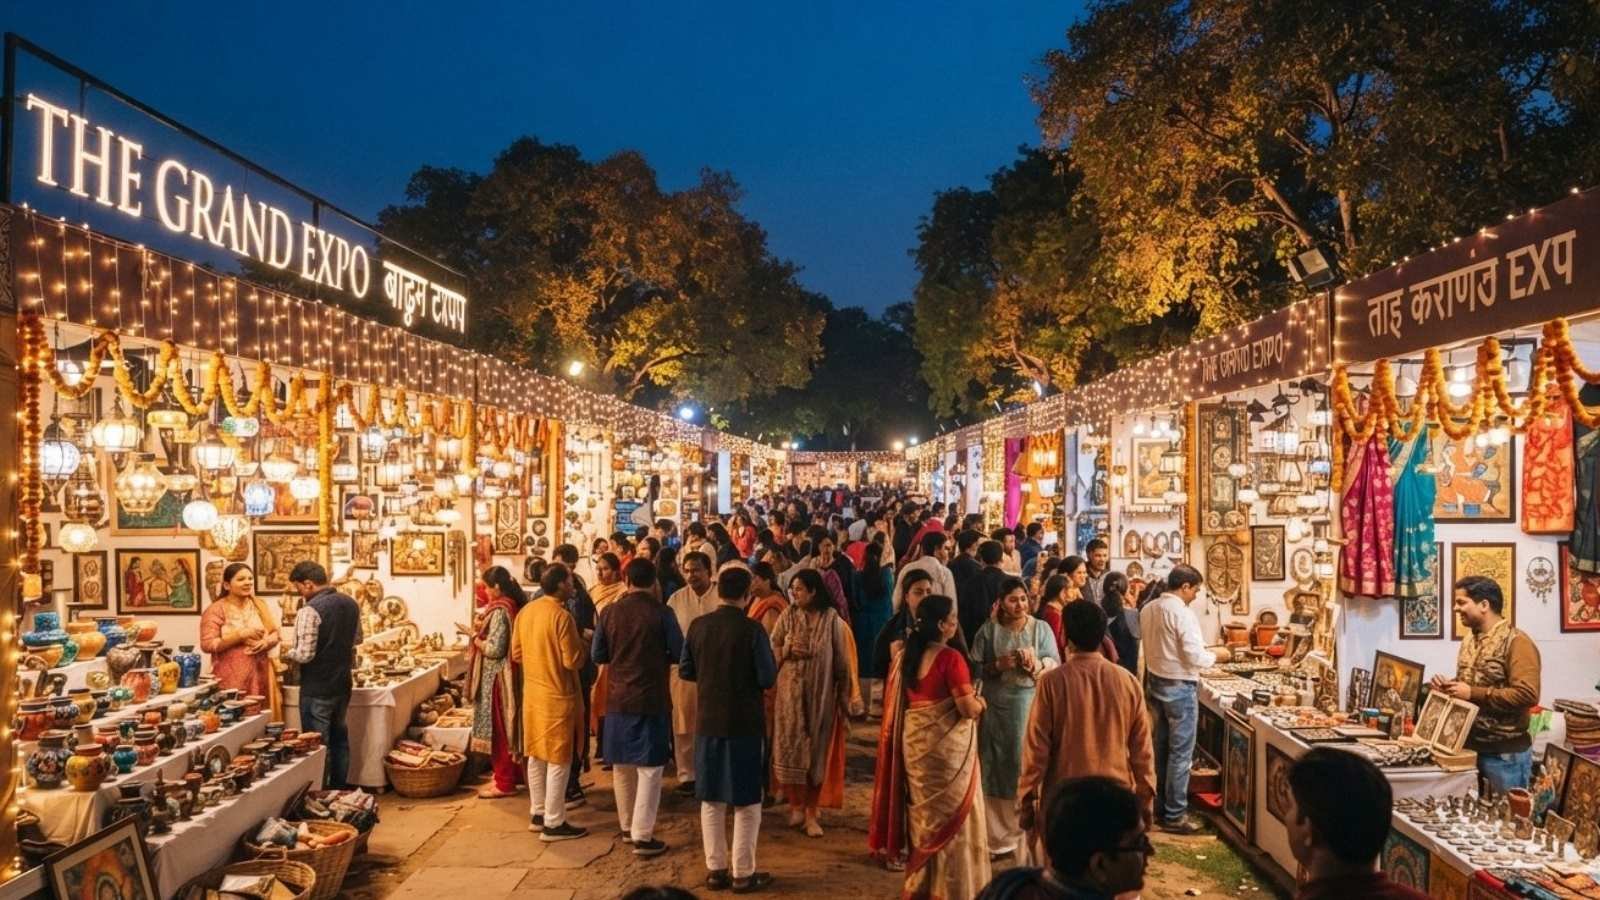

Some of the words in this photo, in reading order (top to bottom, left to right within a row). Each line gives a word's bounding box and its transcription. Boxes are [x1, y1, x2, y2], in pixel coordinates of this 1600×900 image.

[26, 93, 143, 217] THE
[156, 159, 293, 270] GRAND
[301, 220, 370, 299] EXPO
[1252, 332, 1284, 370] EXPO
